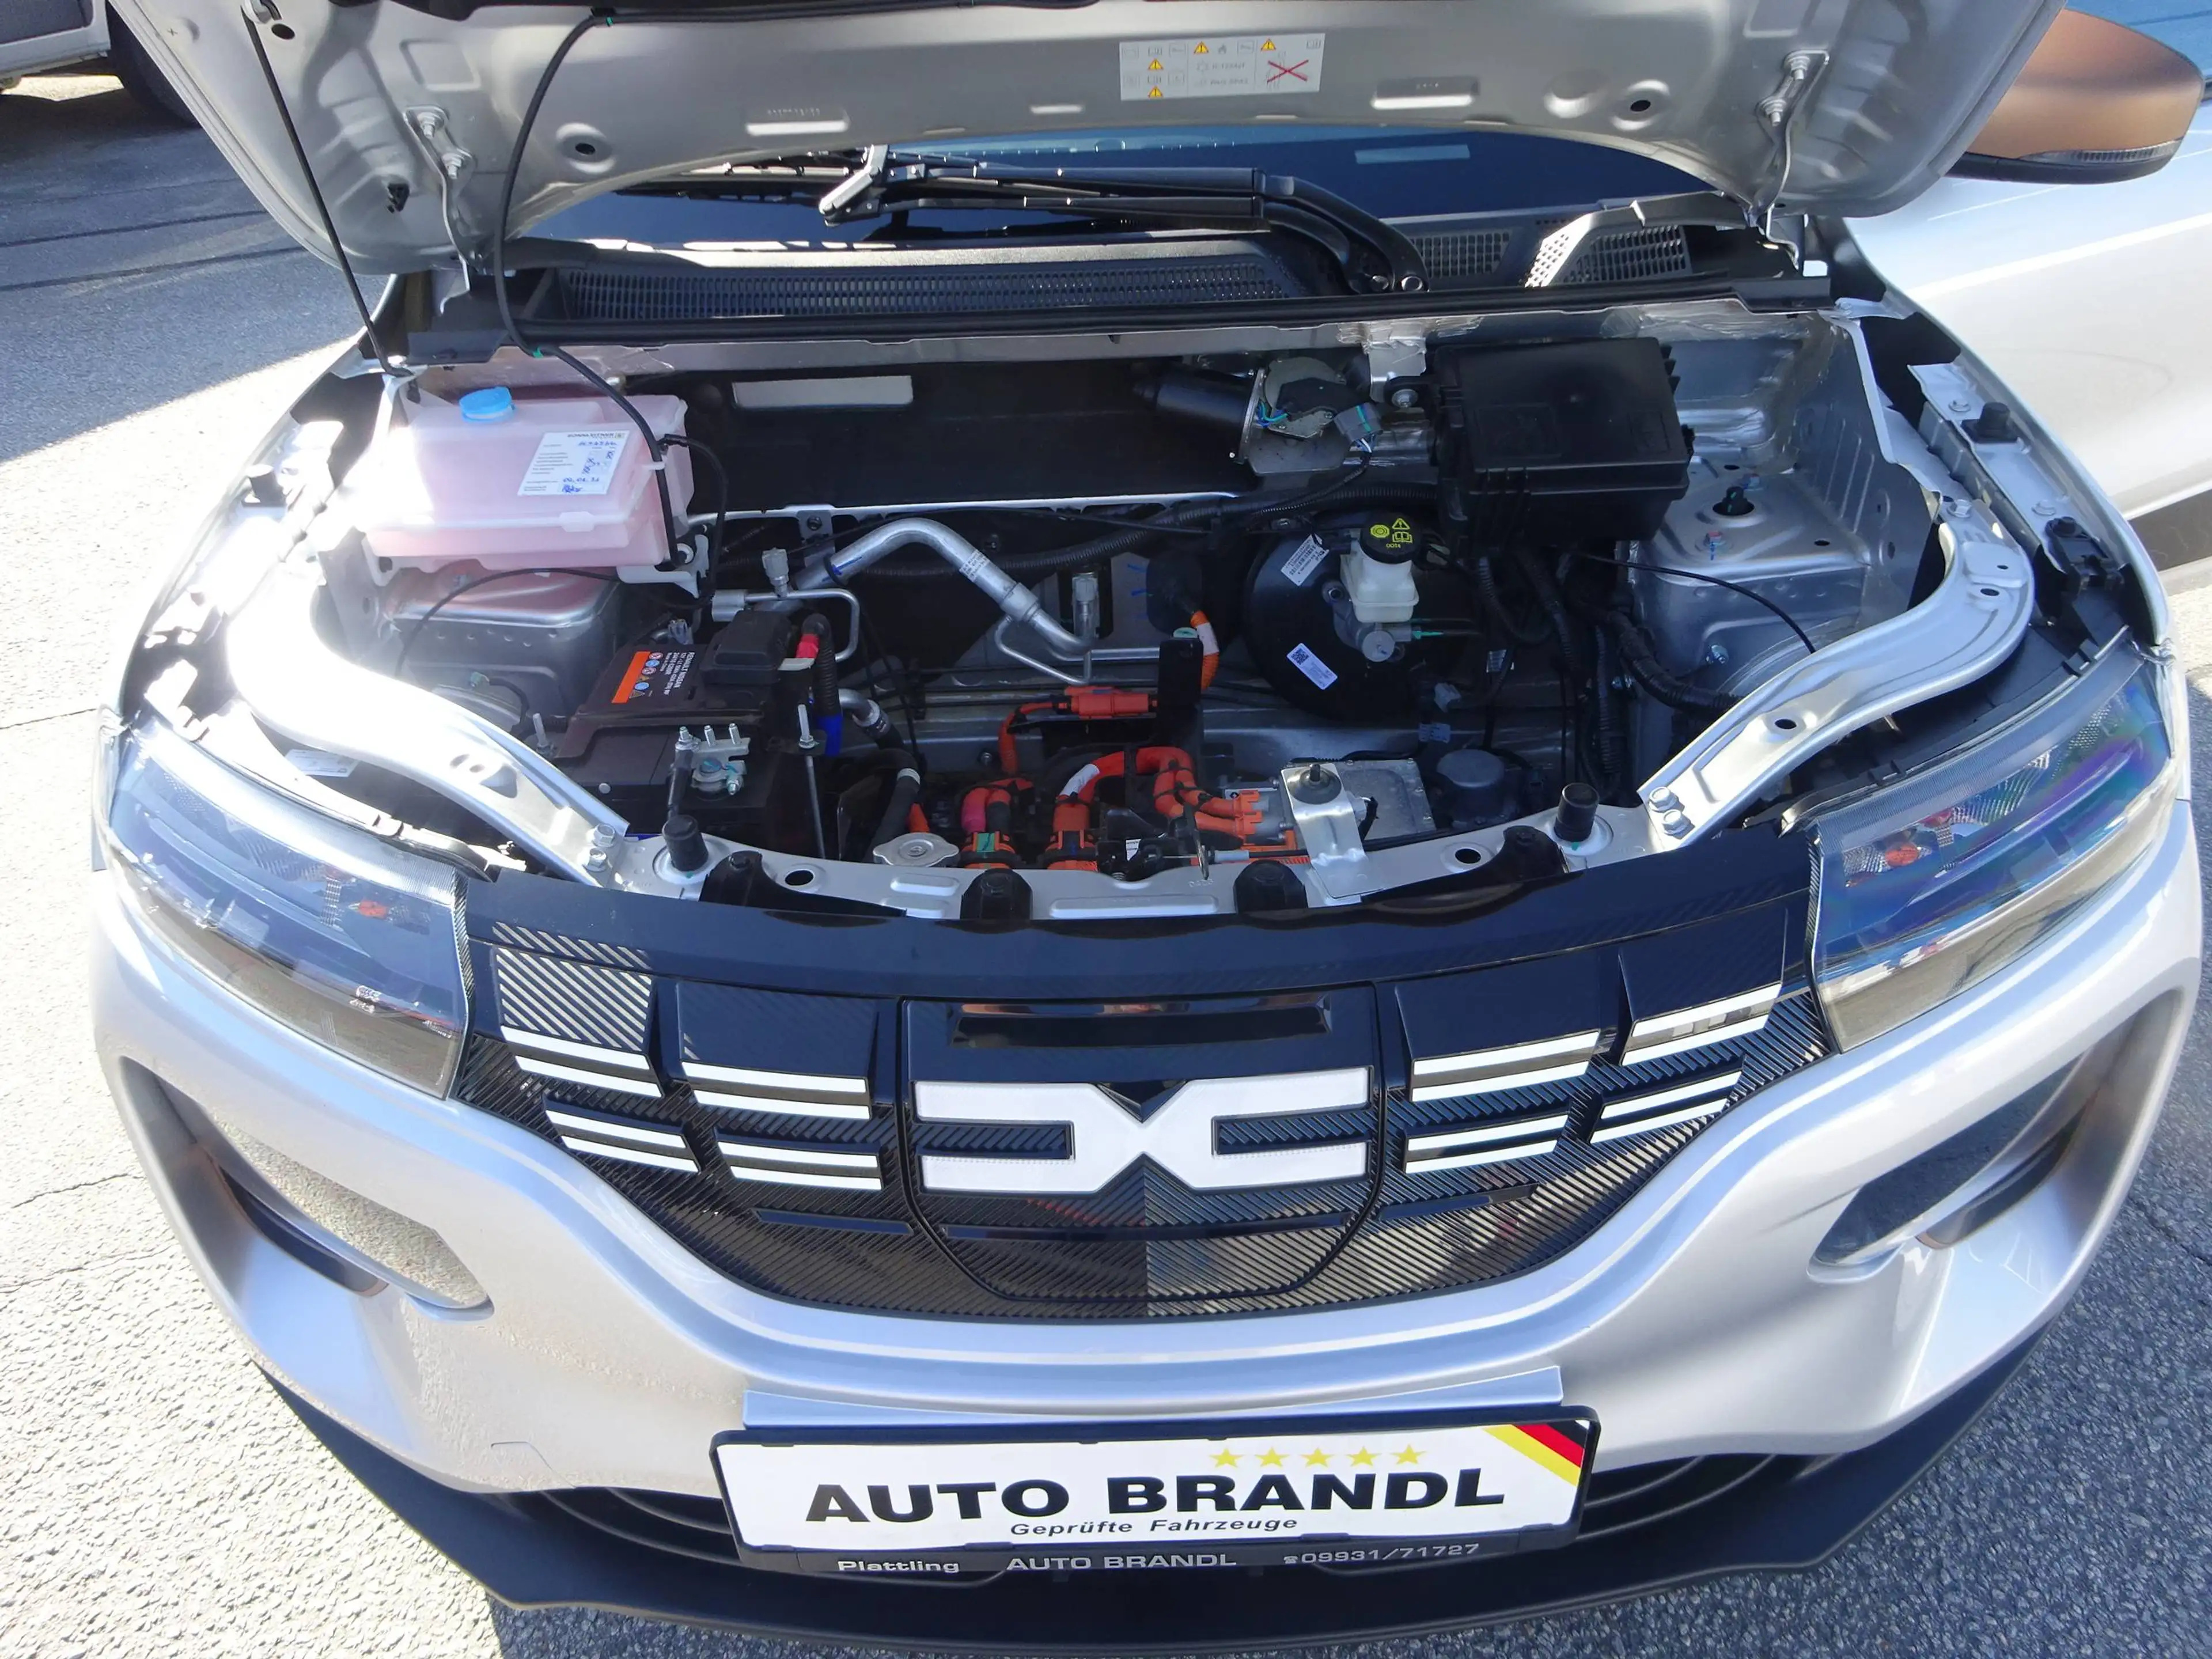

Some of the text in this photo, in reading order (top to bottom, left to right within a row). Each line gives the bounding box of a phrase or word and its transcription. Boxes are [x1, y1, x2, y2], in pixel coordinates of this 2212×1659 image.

[806, 1468, 1505, 1522] AUTO BRANDL
[1010, 1518, 1297, 1537] Geprüfte Fahrzeuge
[838, 1543, 1479, 1573] Plattling AUTO BRANDL 09931/71727
